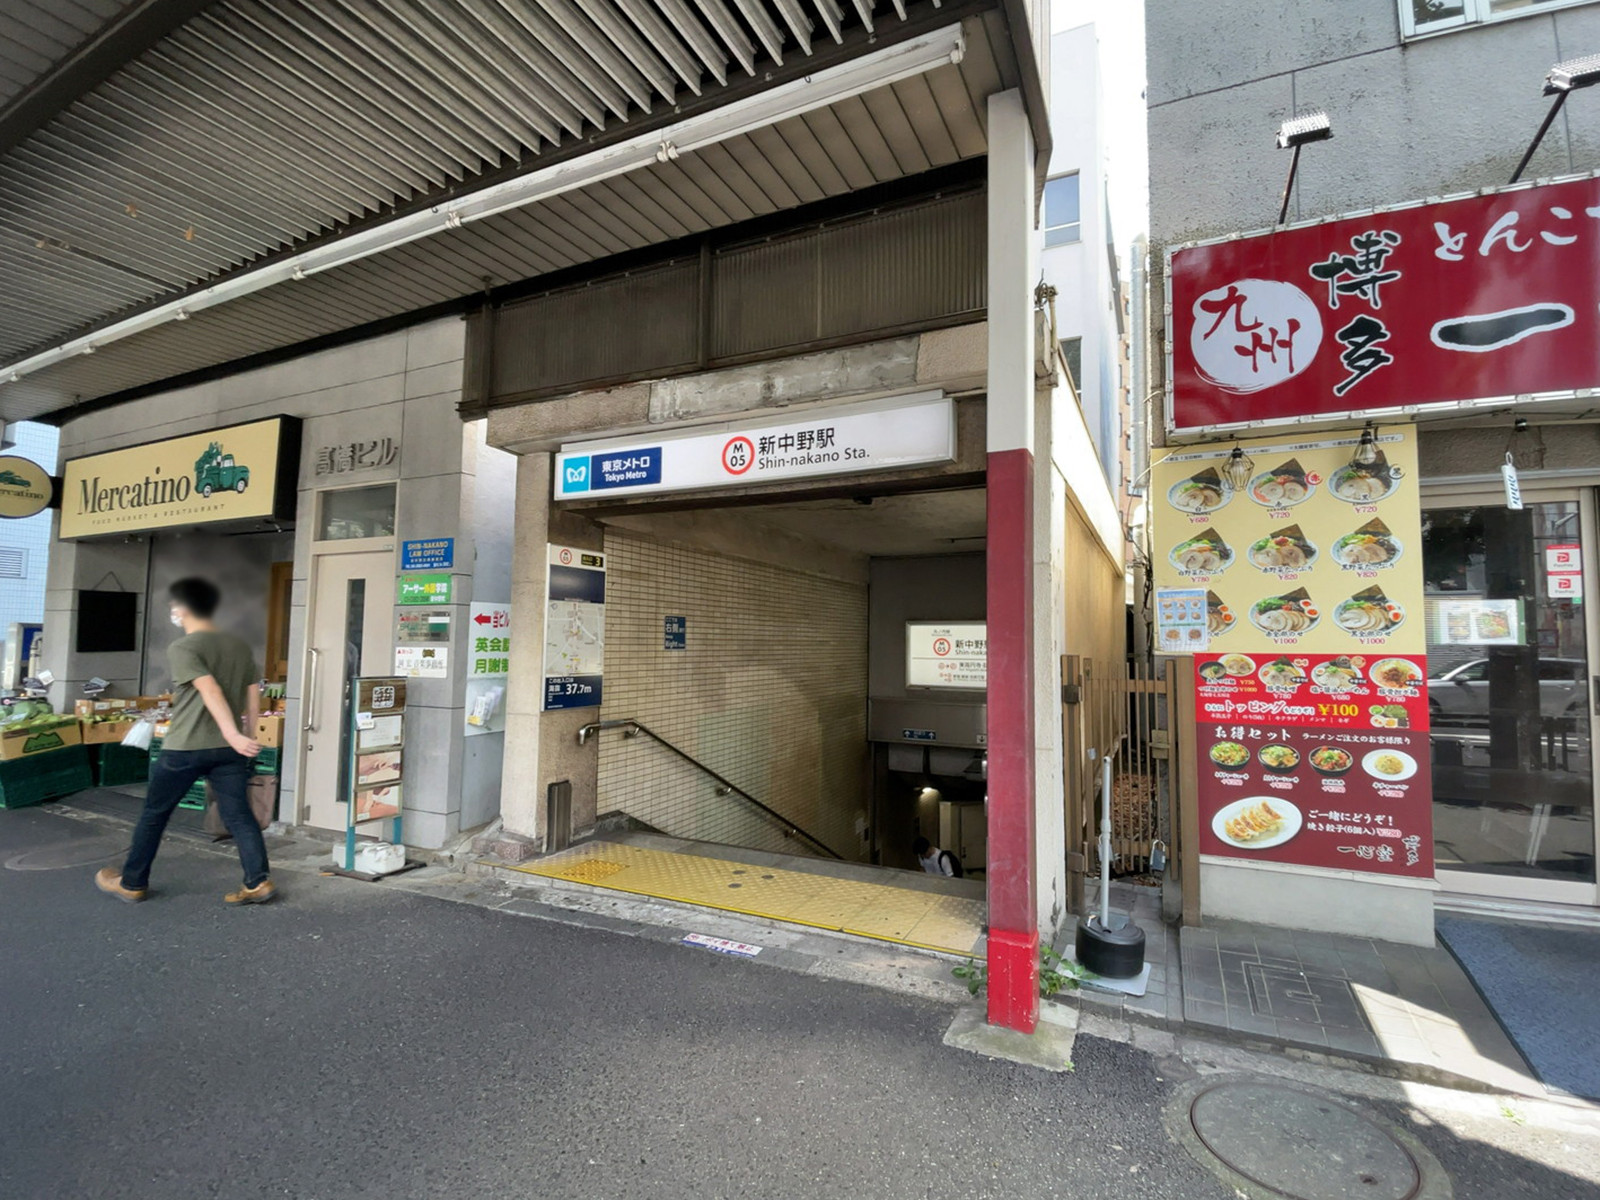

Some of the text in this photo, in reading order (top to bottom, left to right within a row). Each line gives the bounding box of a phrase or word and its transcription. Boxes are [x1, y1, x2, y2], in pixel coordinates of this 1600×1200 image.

[1433, 206, 1600, 262] とんこ
[1309, 230, 1401, 397] 博多
[1200, 285, 1301, 375] 九州
[733, 443, 743, 453] M
[759, 427, 835, 455] 新中野駅
[602, 456, 650, 472] 東京メトロ
[730, 455, 746, 467] 05
[759, 448, 870, 470] Shin-nakano Sta.
[605, 470, 647, 482] Tokyo Metro
[78, 465, 191, 516] Mercatino
[423, 548, 445, 556] OFFICE
[955, 640, 987, 650] 新中野
[566, 683, 592, 695] 37.7m
[1318, 703, 1359, 717] ¥100
[1215, 725, 1291, 741] お得セット
